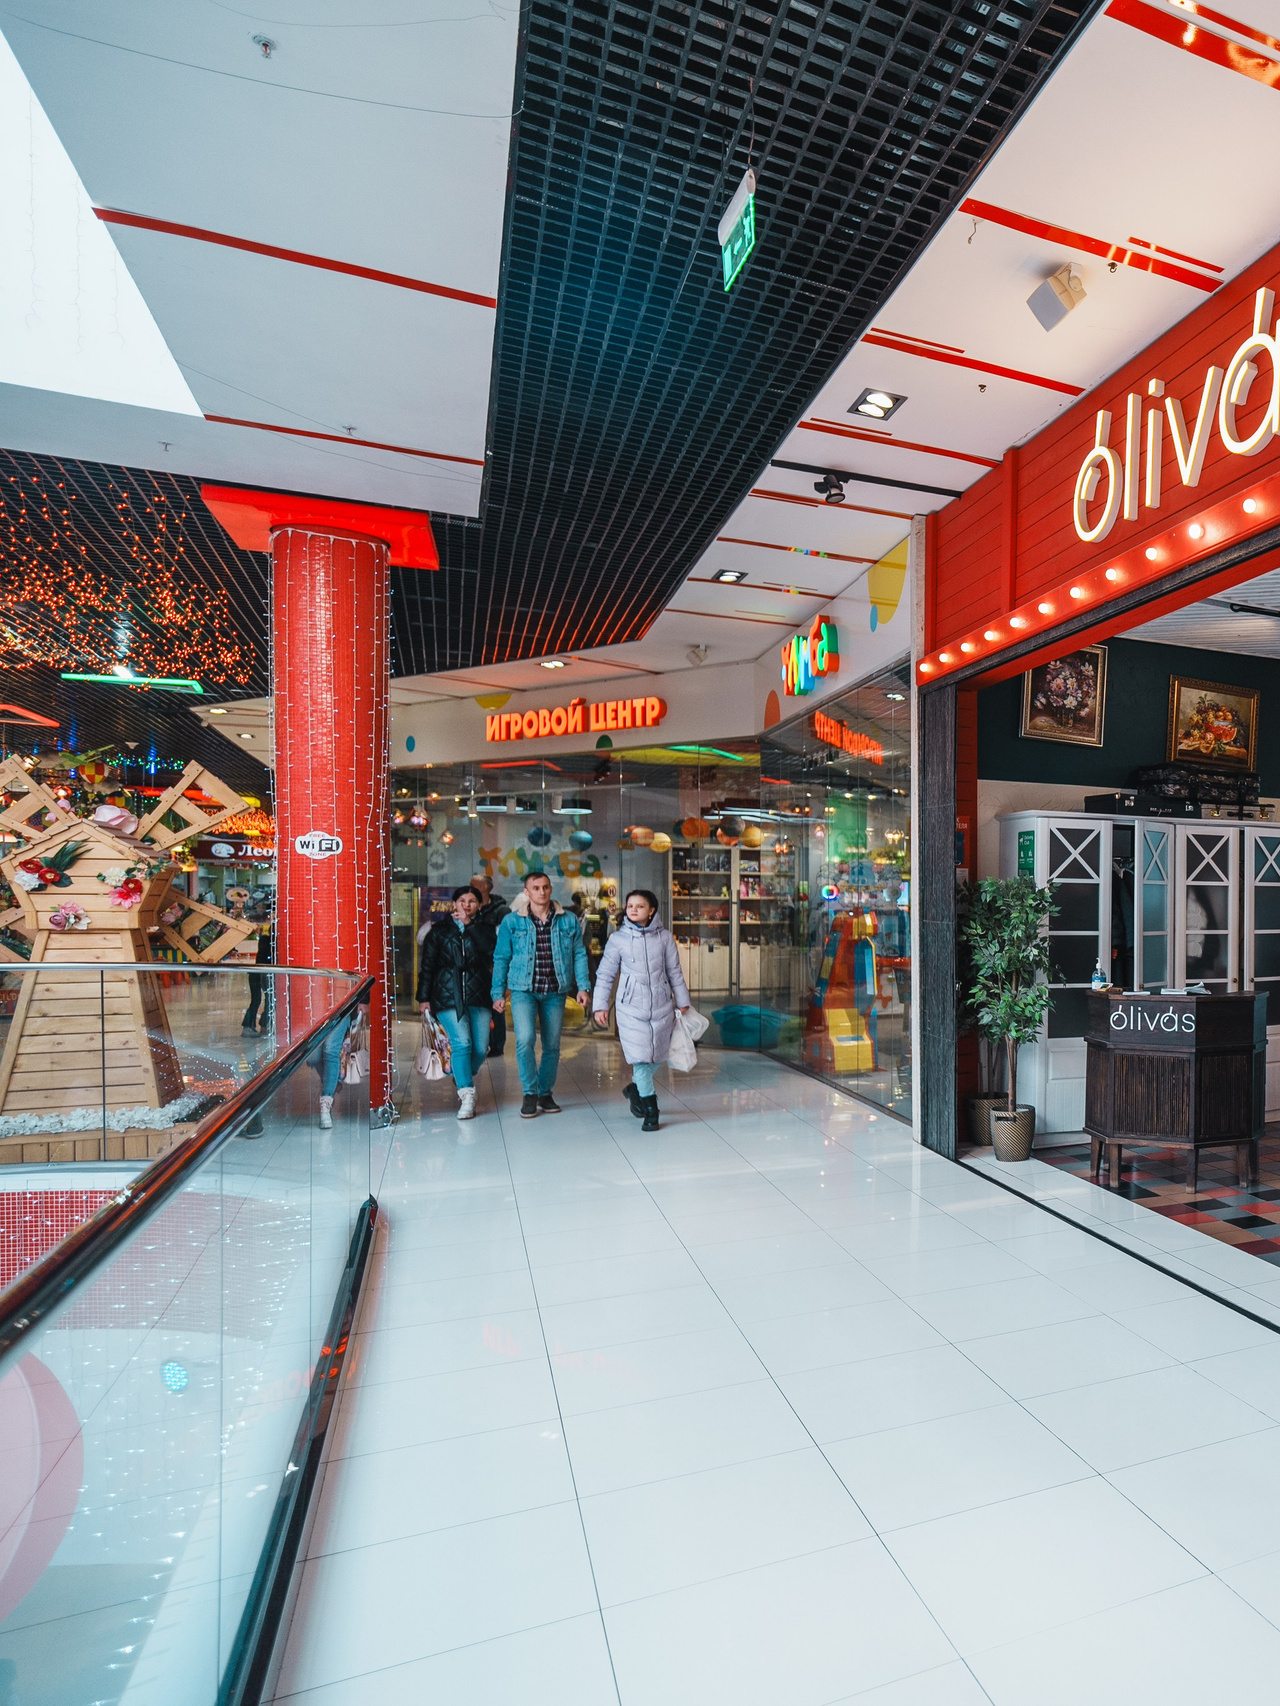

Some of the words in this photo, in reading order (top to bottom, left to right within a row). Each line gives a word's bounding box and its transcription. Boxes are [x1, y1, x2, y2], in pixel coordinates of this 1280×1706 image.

[486, 697, 587, 742] ИГРОВОЙ
[590, 696, 664, 732] ЦЕНТР
[238, 844, 277, 857] Лео
